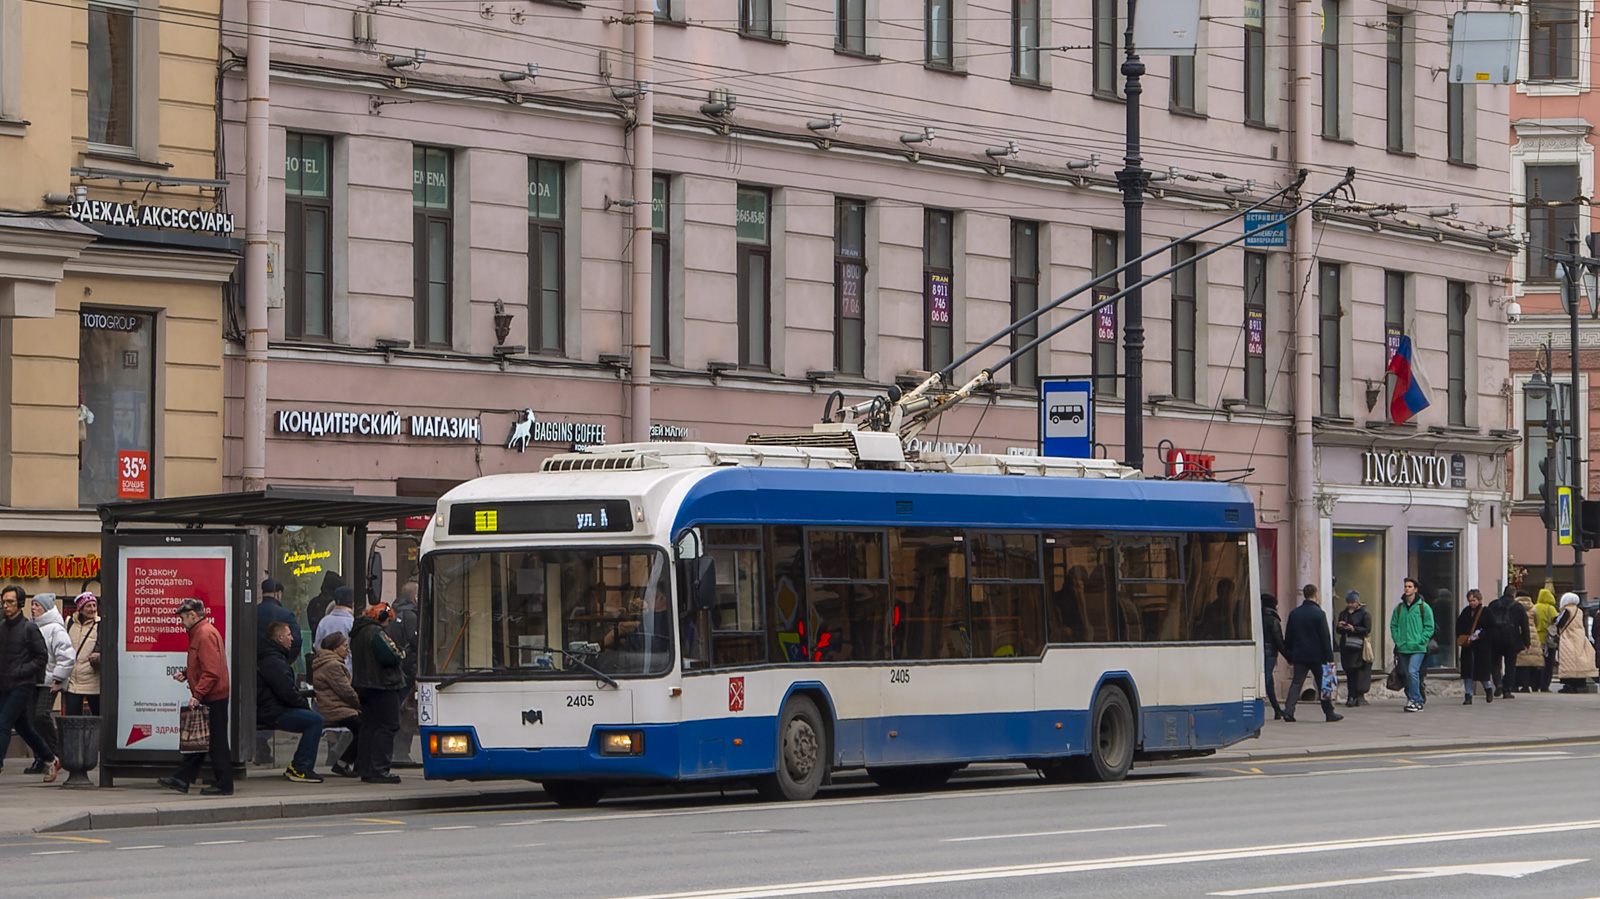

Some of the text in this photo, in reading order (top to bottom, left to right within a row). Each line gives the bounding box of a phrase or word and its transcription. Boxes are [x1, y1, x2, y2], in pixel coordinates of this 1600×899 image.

[528, 181, 551, 197] ODA
[70, 200, 234, 233] ОДЕЖДА, АКСЕССУАРЫ
[932, 275, 949, 283] FRAN
[843, 280, 857, 296] 222
[937, 285, 948, 297] 911
[935, 298, 946, 309] 746
[83, 313, 136, 330] TOTOGROUP
[931, 310, 949, 323] 06 06
[1101, 315, 1112, 327] 746
[1098, 328, 1115, 340] 06 06
[279, 411, 478, 439] КОНДИТЕРСКИЙ МАГАЗИН
[649, 424, 663, 437] ЗЕЙ
[534, 422, 607, 444] BAGGINS COFFEE
[120, 456, 147, 478] -35%
[1365, 452, 1448, 486] INCANTO
[483, 512, 488, 529] 1
[577, 513, 596, 529] ул.
[0, 554, 101, 578] Н ЖЕН КИТАЙ
[135, 567, 178, 577] По закону
[135, 578, 193, 587] работодатель
[135, 587, 165, 595] обязан
[135, 598, 185, 606] предостави
[134, 607, 151, 615] для
[134, 626, 188, 634] оплачиваем
[133, 636, 158, 644] день.
[890, 669, 910, 684] 2405
[566, 695, 594, 707] 2405
[155, 726, 180, 734] ЗДРАВ
